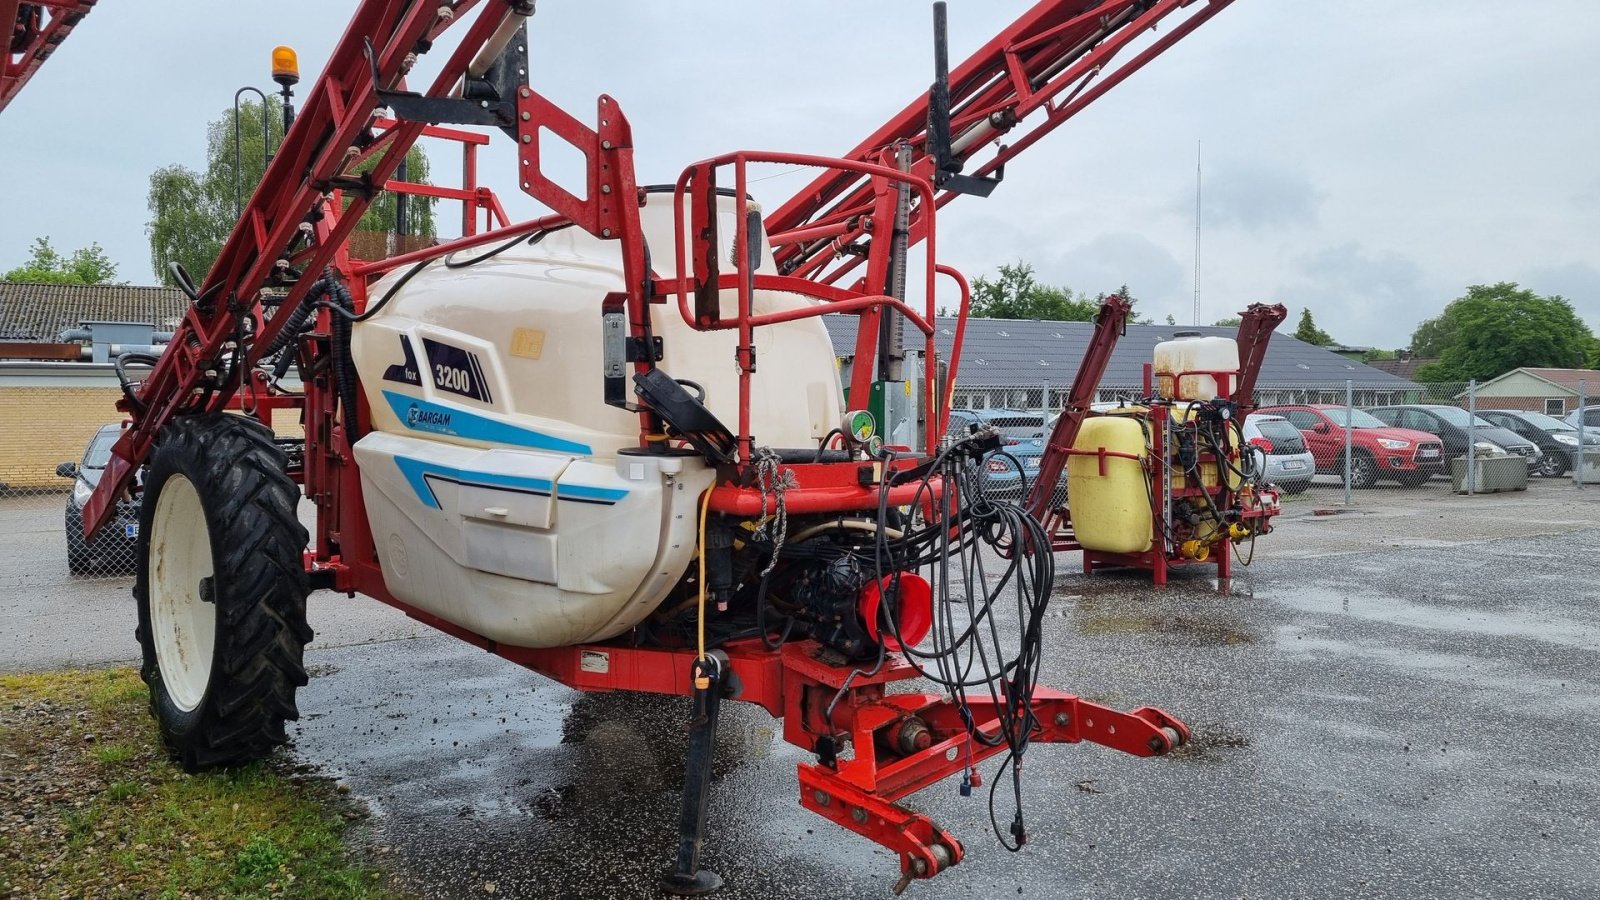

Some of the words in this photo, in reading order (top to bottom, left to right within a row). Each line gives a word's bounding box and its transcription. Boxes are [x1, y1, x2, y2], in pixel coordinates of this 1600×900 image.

[405, 368, 417, 381] fox
[436, 364, 470, 393] 3200
[418, 411, 451, 426] BARGAM
